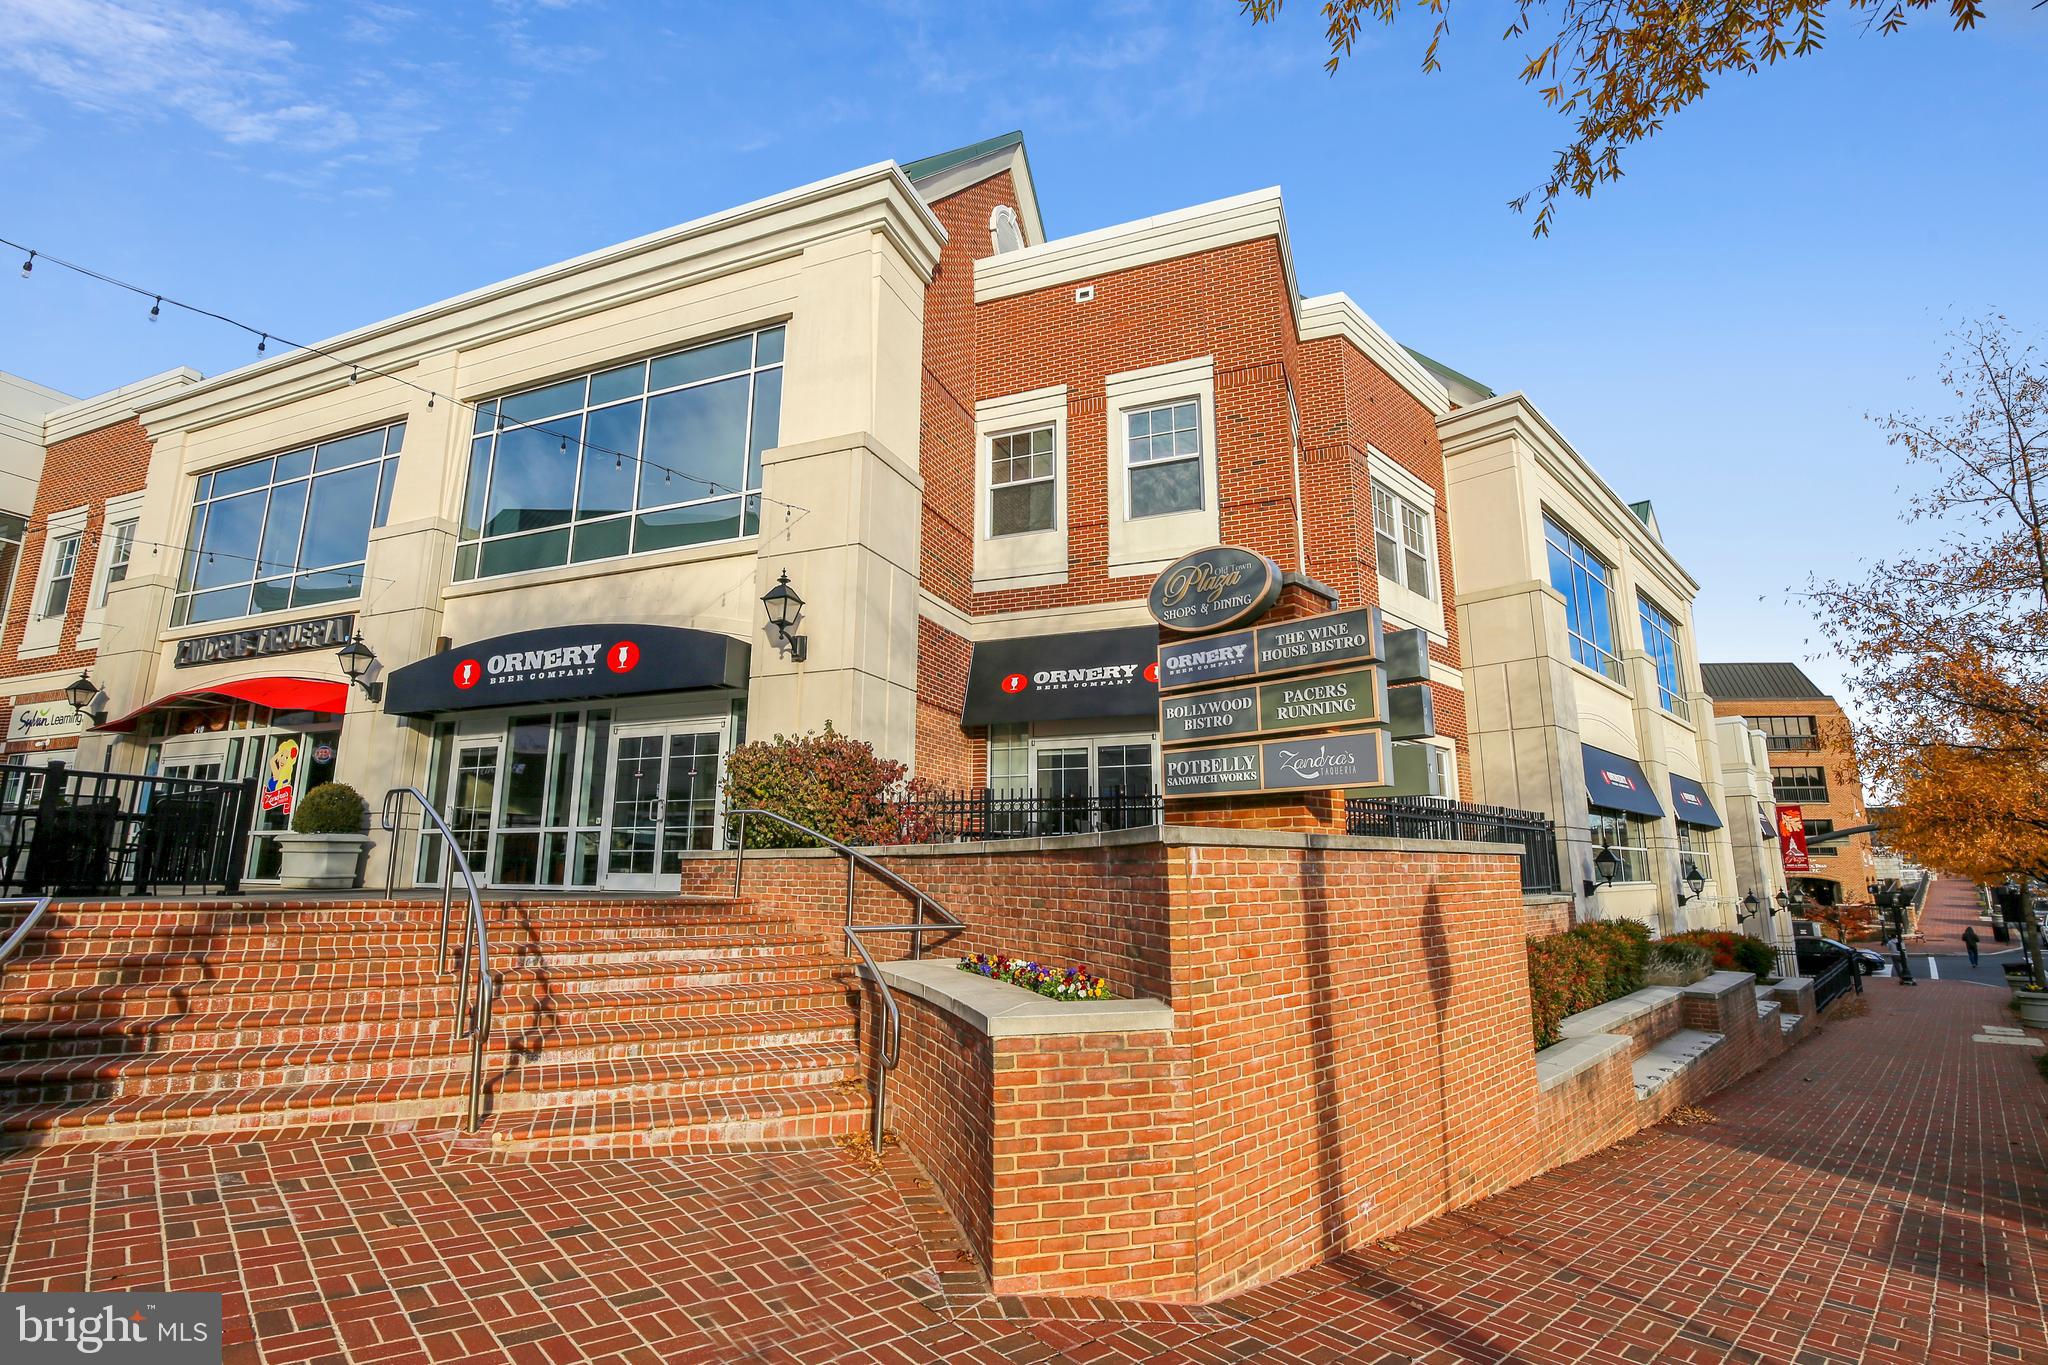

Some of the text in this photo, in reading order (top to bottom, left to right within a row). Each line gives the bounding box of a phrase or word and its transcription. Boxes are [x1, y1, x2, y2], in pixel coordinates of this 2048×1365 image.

[1214, 562, 1252, 576] Old Town
[1162, 562, 1241, 607] Plaza
[1163, 594, 1252, 621] SHOPS & DINING
[1275, 622, 1349, 646] THE WINE
[1166, 643, 1248, 670] ORNERY
[1261, 633, 1366, 663] HOUSE BISTRO
[487, 643, 602, 675] ORNERY
[1169, 658, 1244, 675] BEER COMPANY
[489, 667, 595, 685] BEER COMPANY
[1033, 664, 1139, 684] ORNERY
[1073, 679, 1133, 688] COMPANY
[1283, 683, 1347, 704] PACERS
[1166, 697, 1252, 719] BOLLYWOOD
[1276, 698, 1357, 720] RUNNING
[50, 712, 83, 726] Learning
[1184, 714, 1233, 731] BISTRO
[1167, 755, 1255, 776] POTBELLY
[1279, 745, 1355, 780] Zandra's
[1319, 766, 1357, 777] TAQUERIA
[1167, 771, 1257, 787] SANDWICH WORKS
